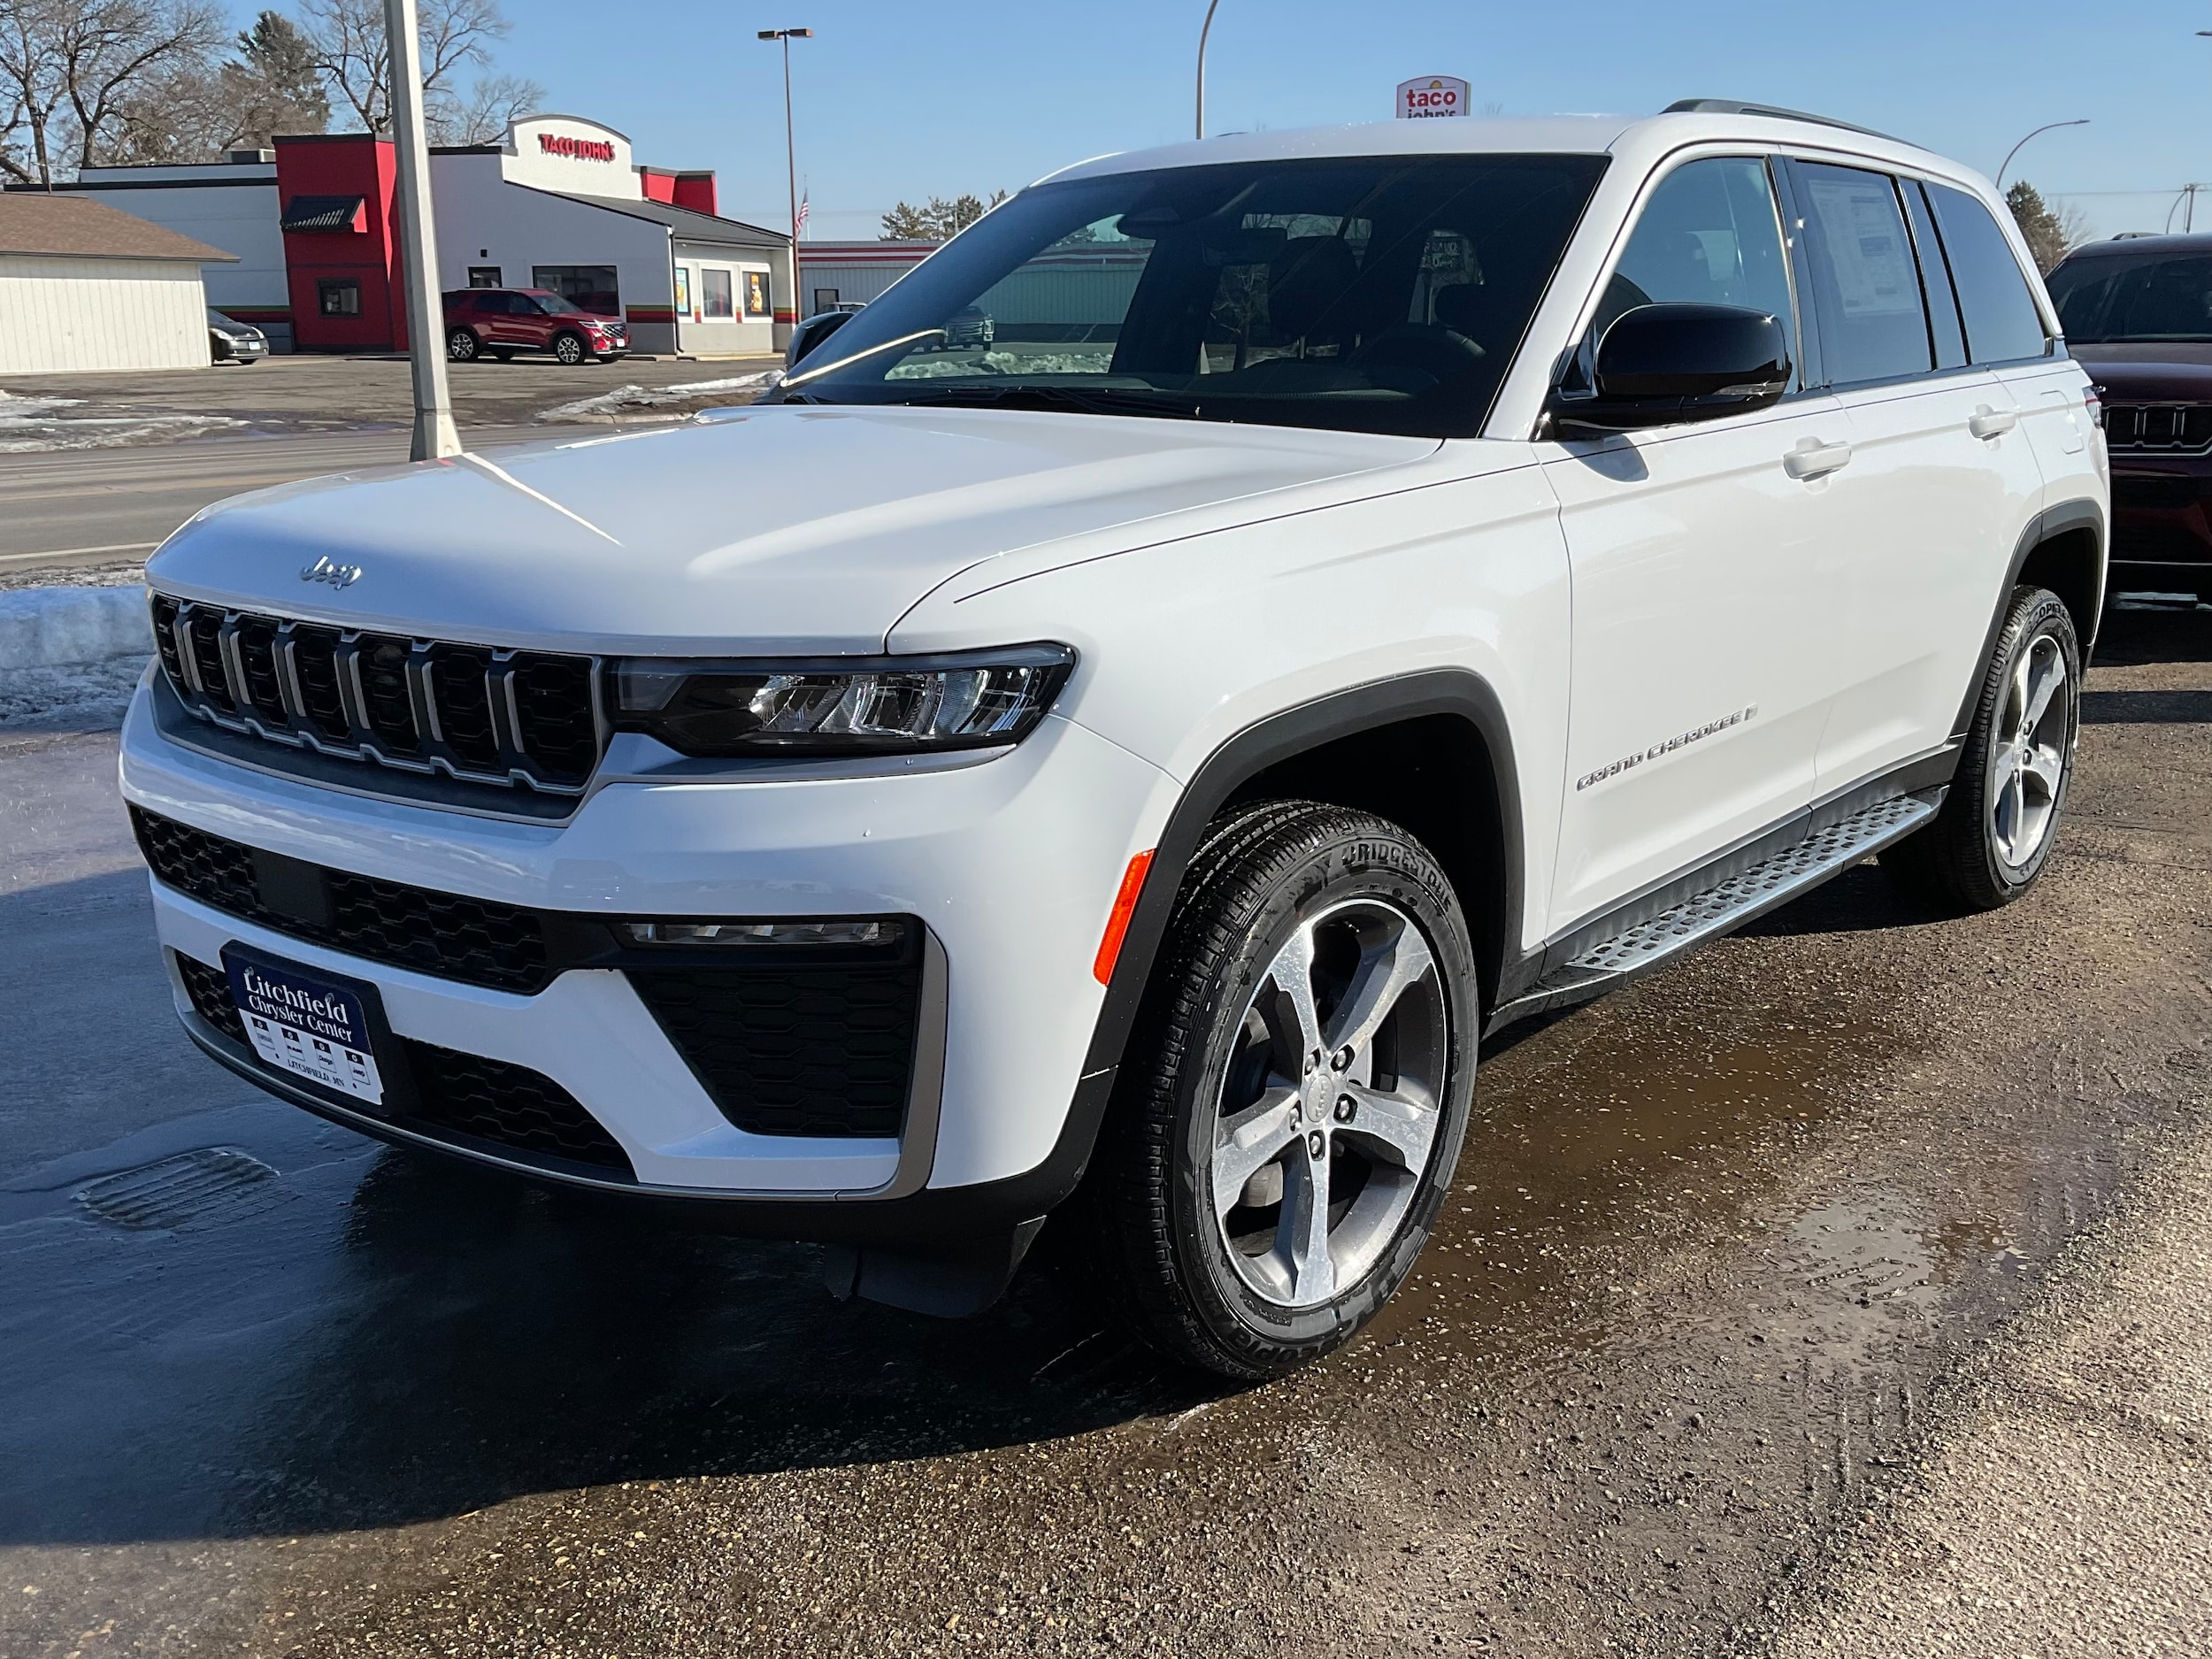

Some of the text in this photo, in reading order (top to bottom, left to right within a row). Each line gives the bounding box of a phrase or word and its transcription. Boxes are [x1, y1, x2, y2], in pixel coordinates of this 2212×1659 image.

[1406, 89, 1456, 108] taco
[538, 134, 616, 162] TACO JOHN'S
[300, 555, 362, 590] Jeep
[1577, 710, 1742, 792] GRAND CHEROKEE
[1341, 843, 1452, 913] BRIDGESTONE
[243, 972, 349, 1025] Litchfield
[249, 995, 352, 1043] Chrysler Center
